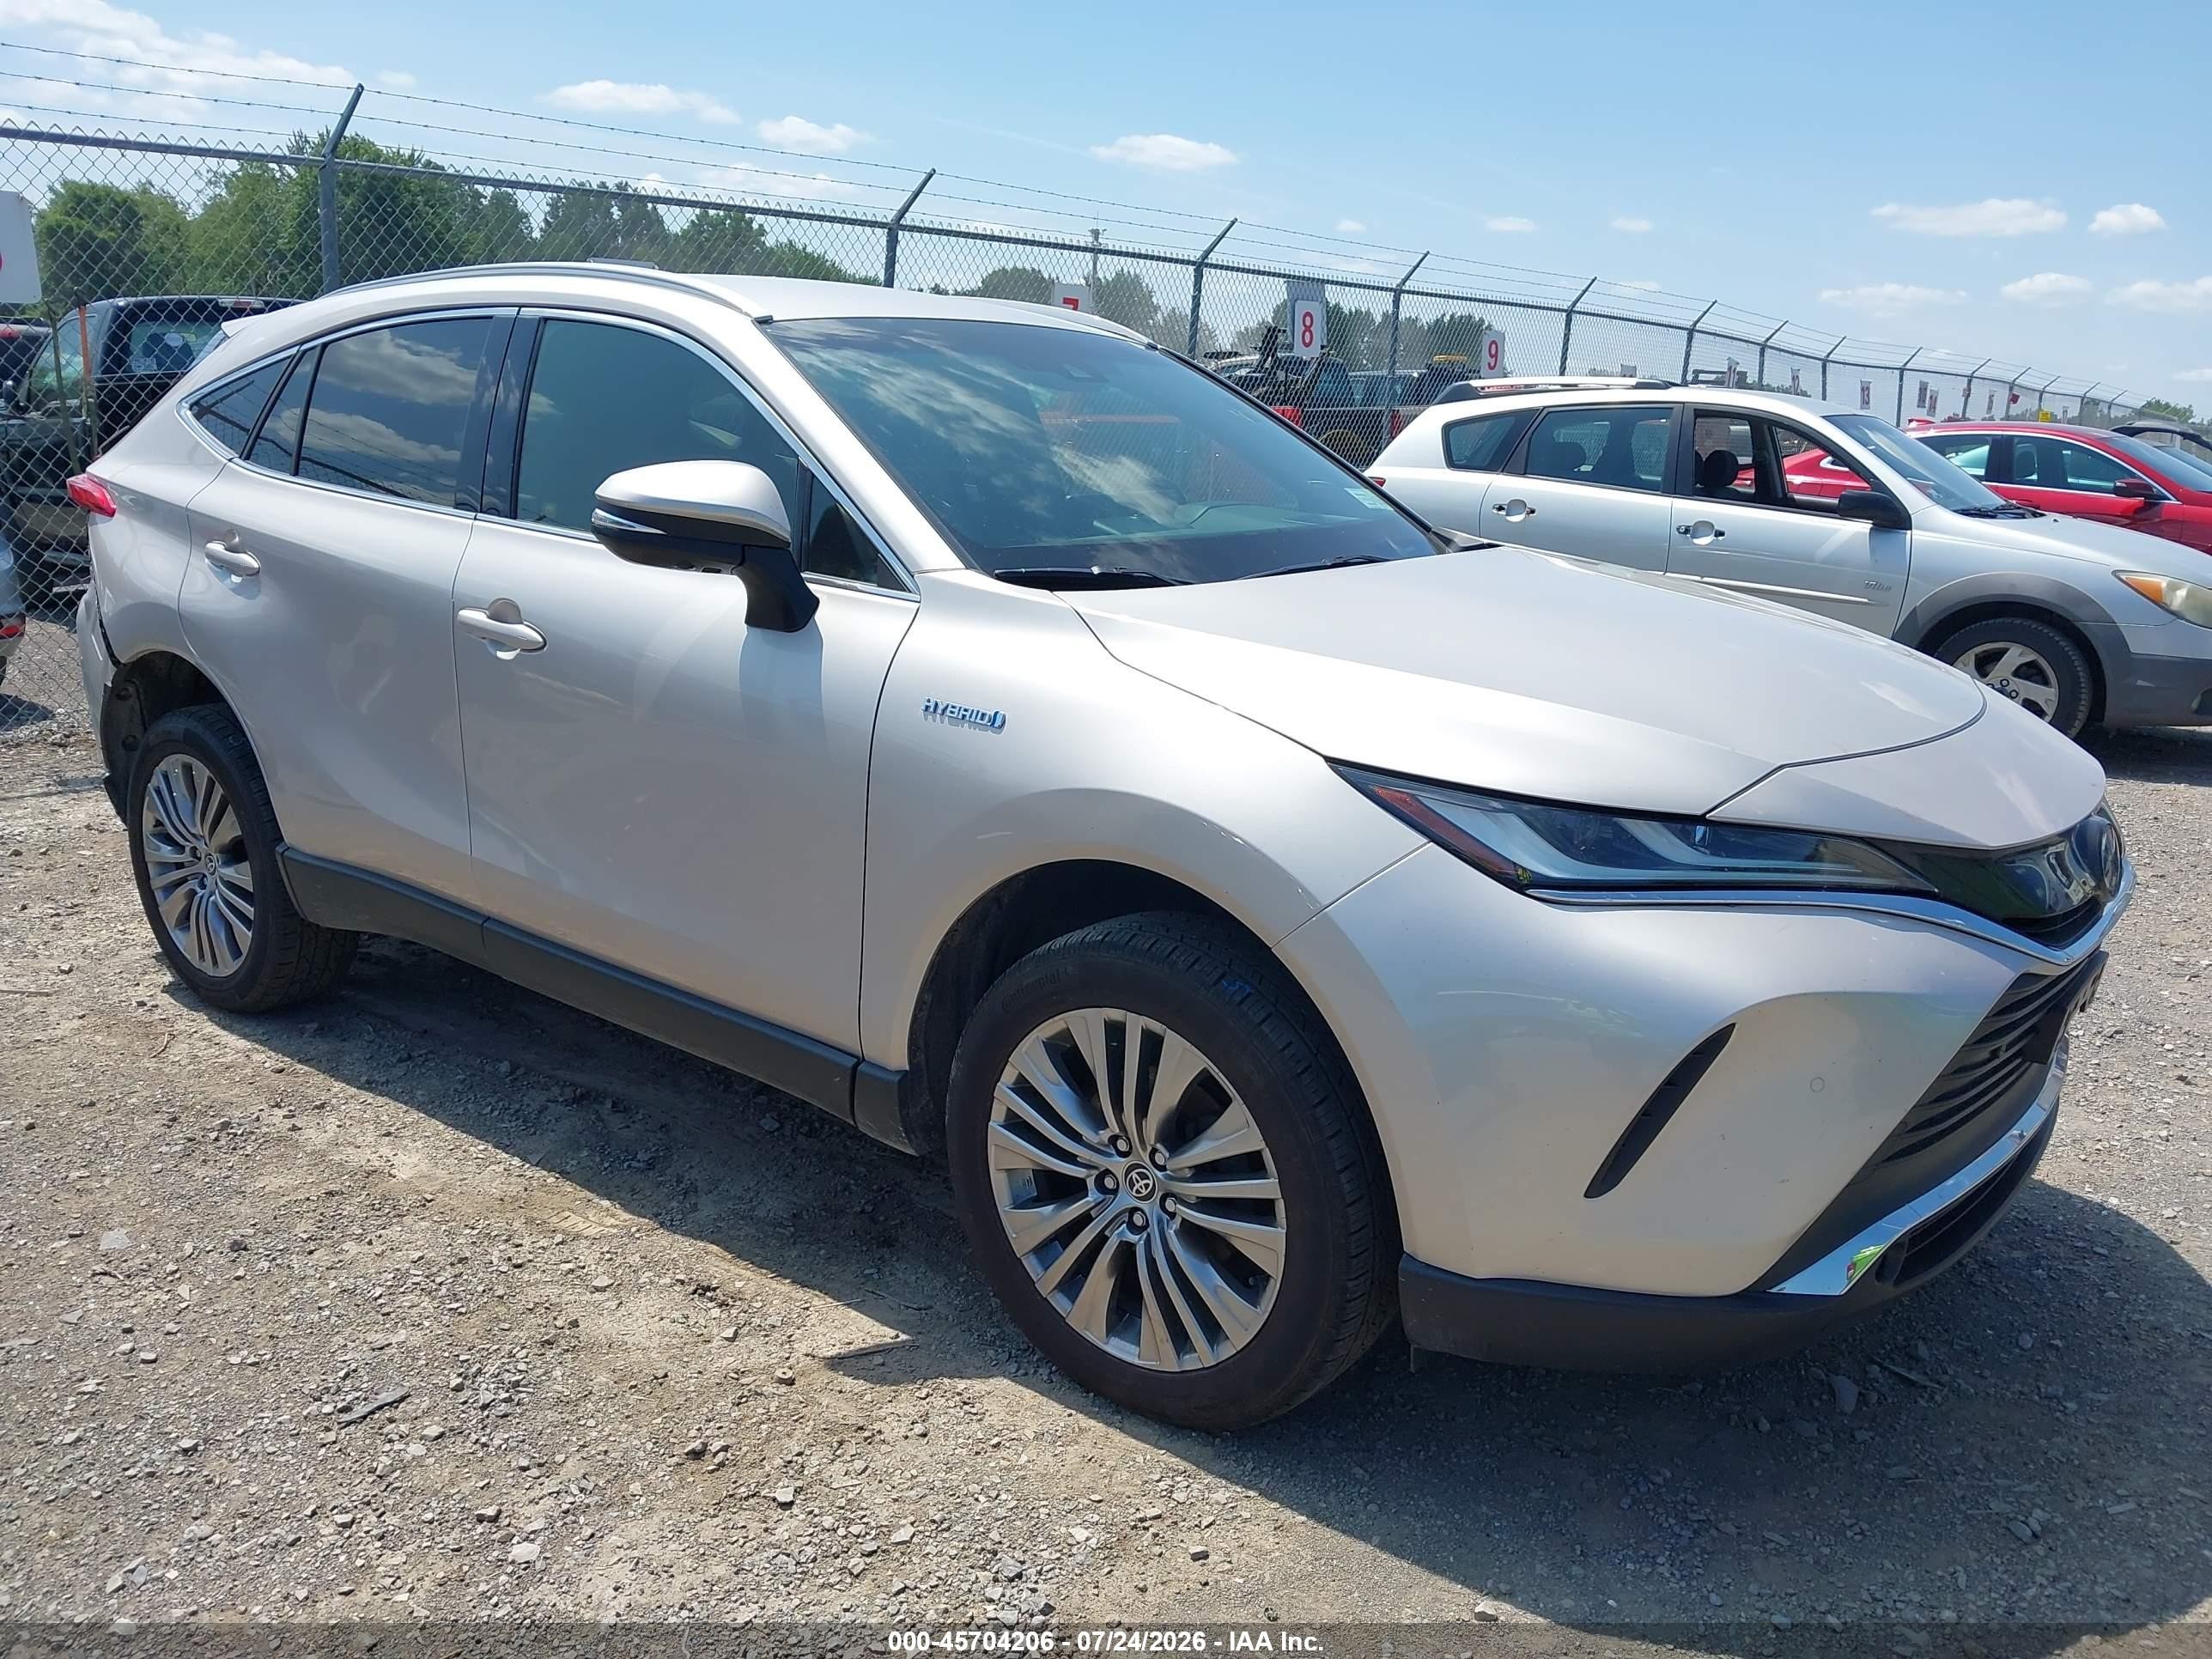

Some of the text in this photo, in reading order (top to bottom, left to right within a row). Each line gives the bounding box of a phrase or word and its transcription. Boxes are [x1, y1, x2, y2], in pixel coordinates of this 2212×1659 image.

[1302, 311, 1314, 348] 8
[1487, 339, 1499, 370] 9
[1861, 386, 1871, 405] 13
[921, 696, 991, 726] HYBRID
